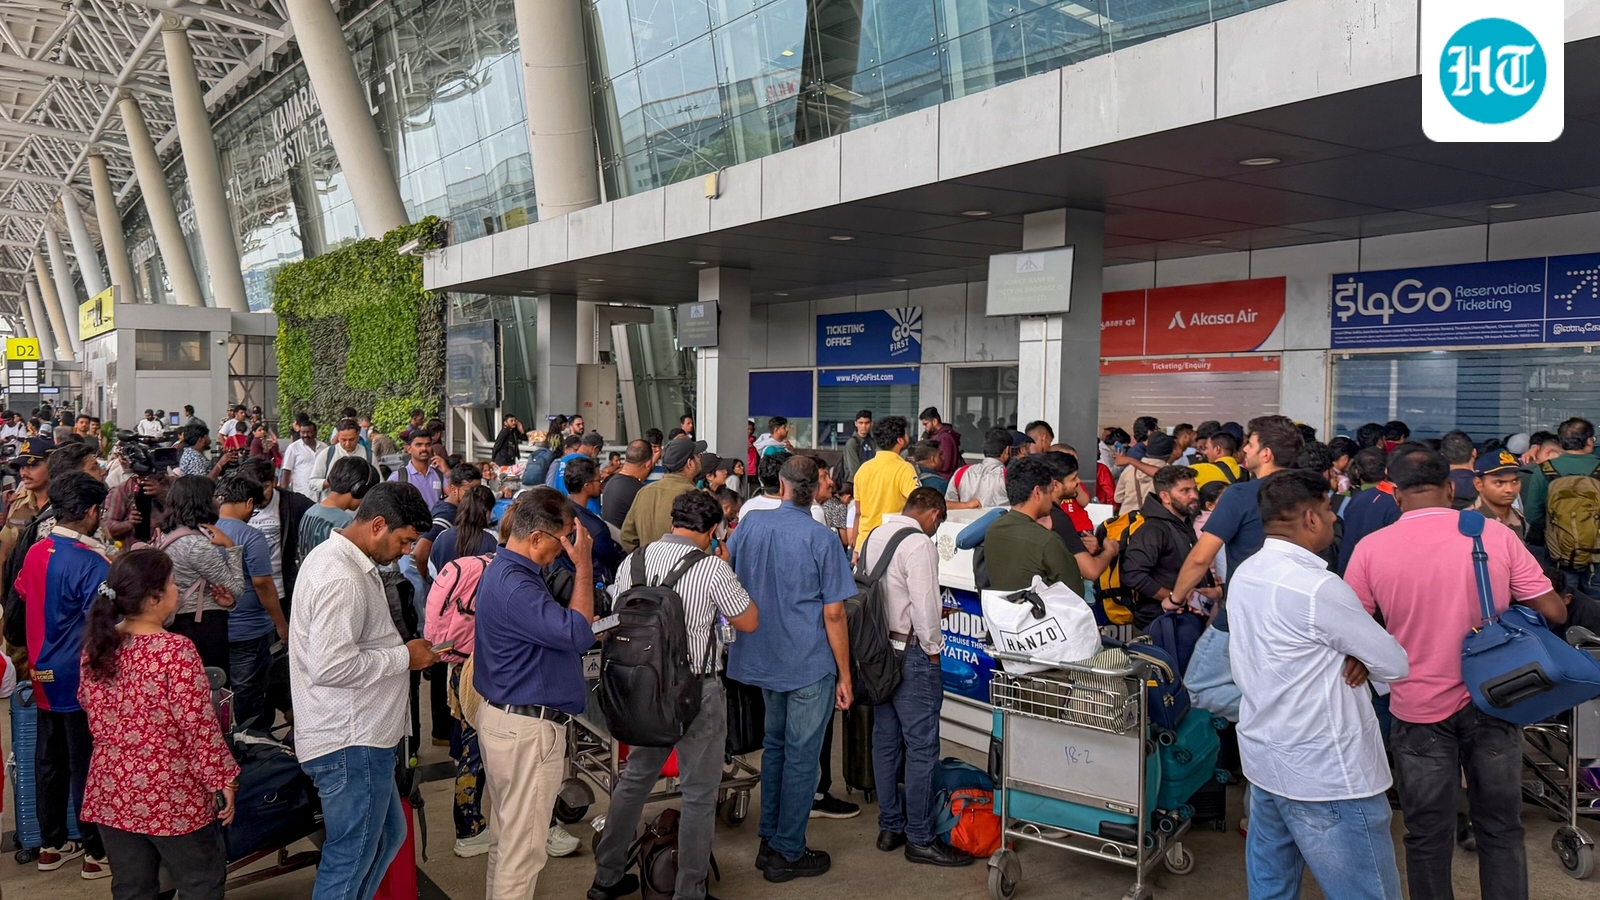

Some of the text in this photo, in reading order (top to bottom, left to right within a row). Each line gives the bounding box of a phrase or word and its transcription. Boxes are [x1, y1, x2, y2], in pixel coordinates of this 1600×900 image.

[271, 80, 320, 141] KAMARA
[259, 125, 311, 184] DOMESTIC
[1455, 283, 1541, 297] Reservations
[1455, 298, 1512, 312] Ticketing
[1190, 308, 1258, 326] Akasa Air
[826, 324, 865, 335] TICKETING
[891, 322, 911, 342] GO
[825, 337, 852, 347] OFFICE
[889, 338, 910, 352] FIRST
[16, 345, 35, 357] D2
[1152, 362, 1212, 371] Ticketing/Enquiry
[836, 373, 894, 383] www.FlyGoFirst.com
[949, 635, 971, 647] CRUISE
[971, 640, 988, 651] THRO
[1006, 627, 1058, 651] HANZO
[940, 645, 980, 665] YATRA
